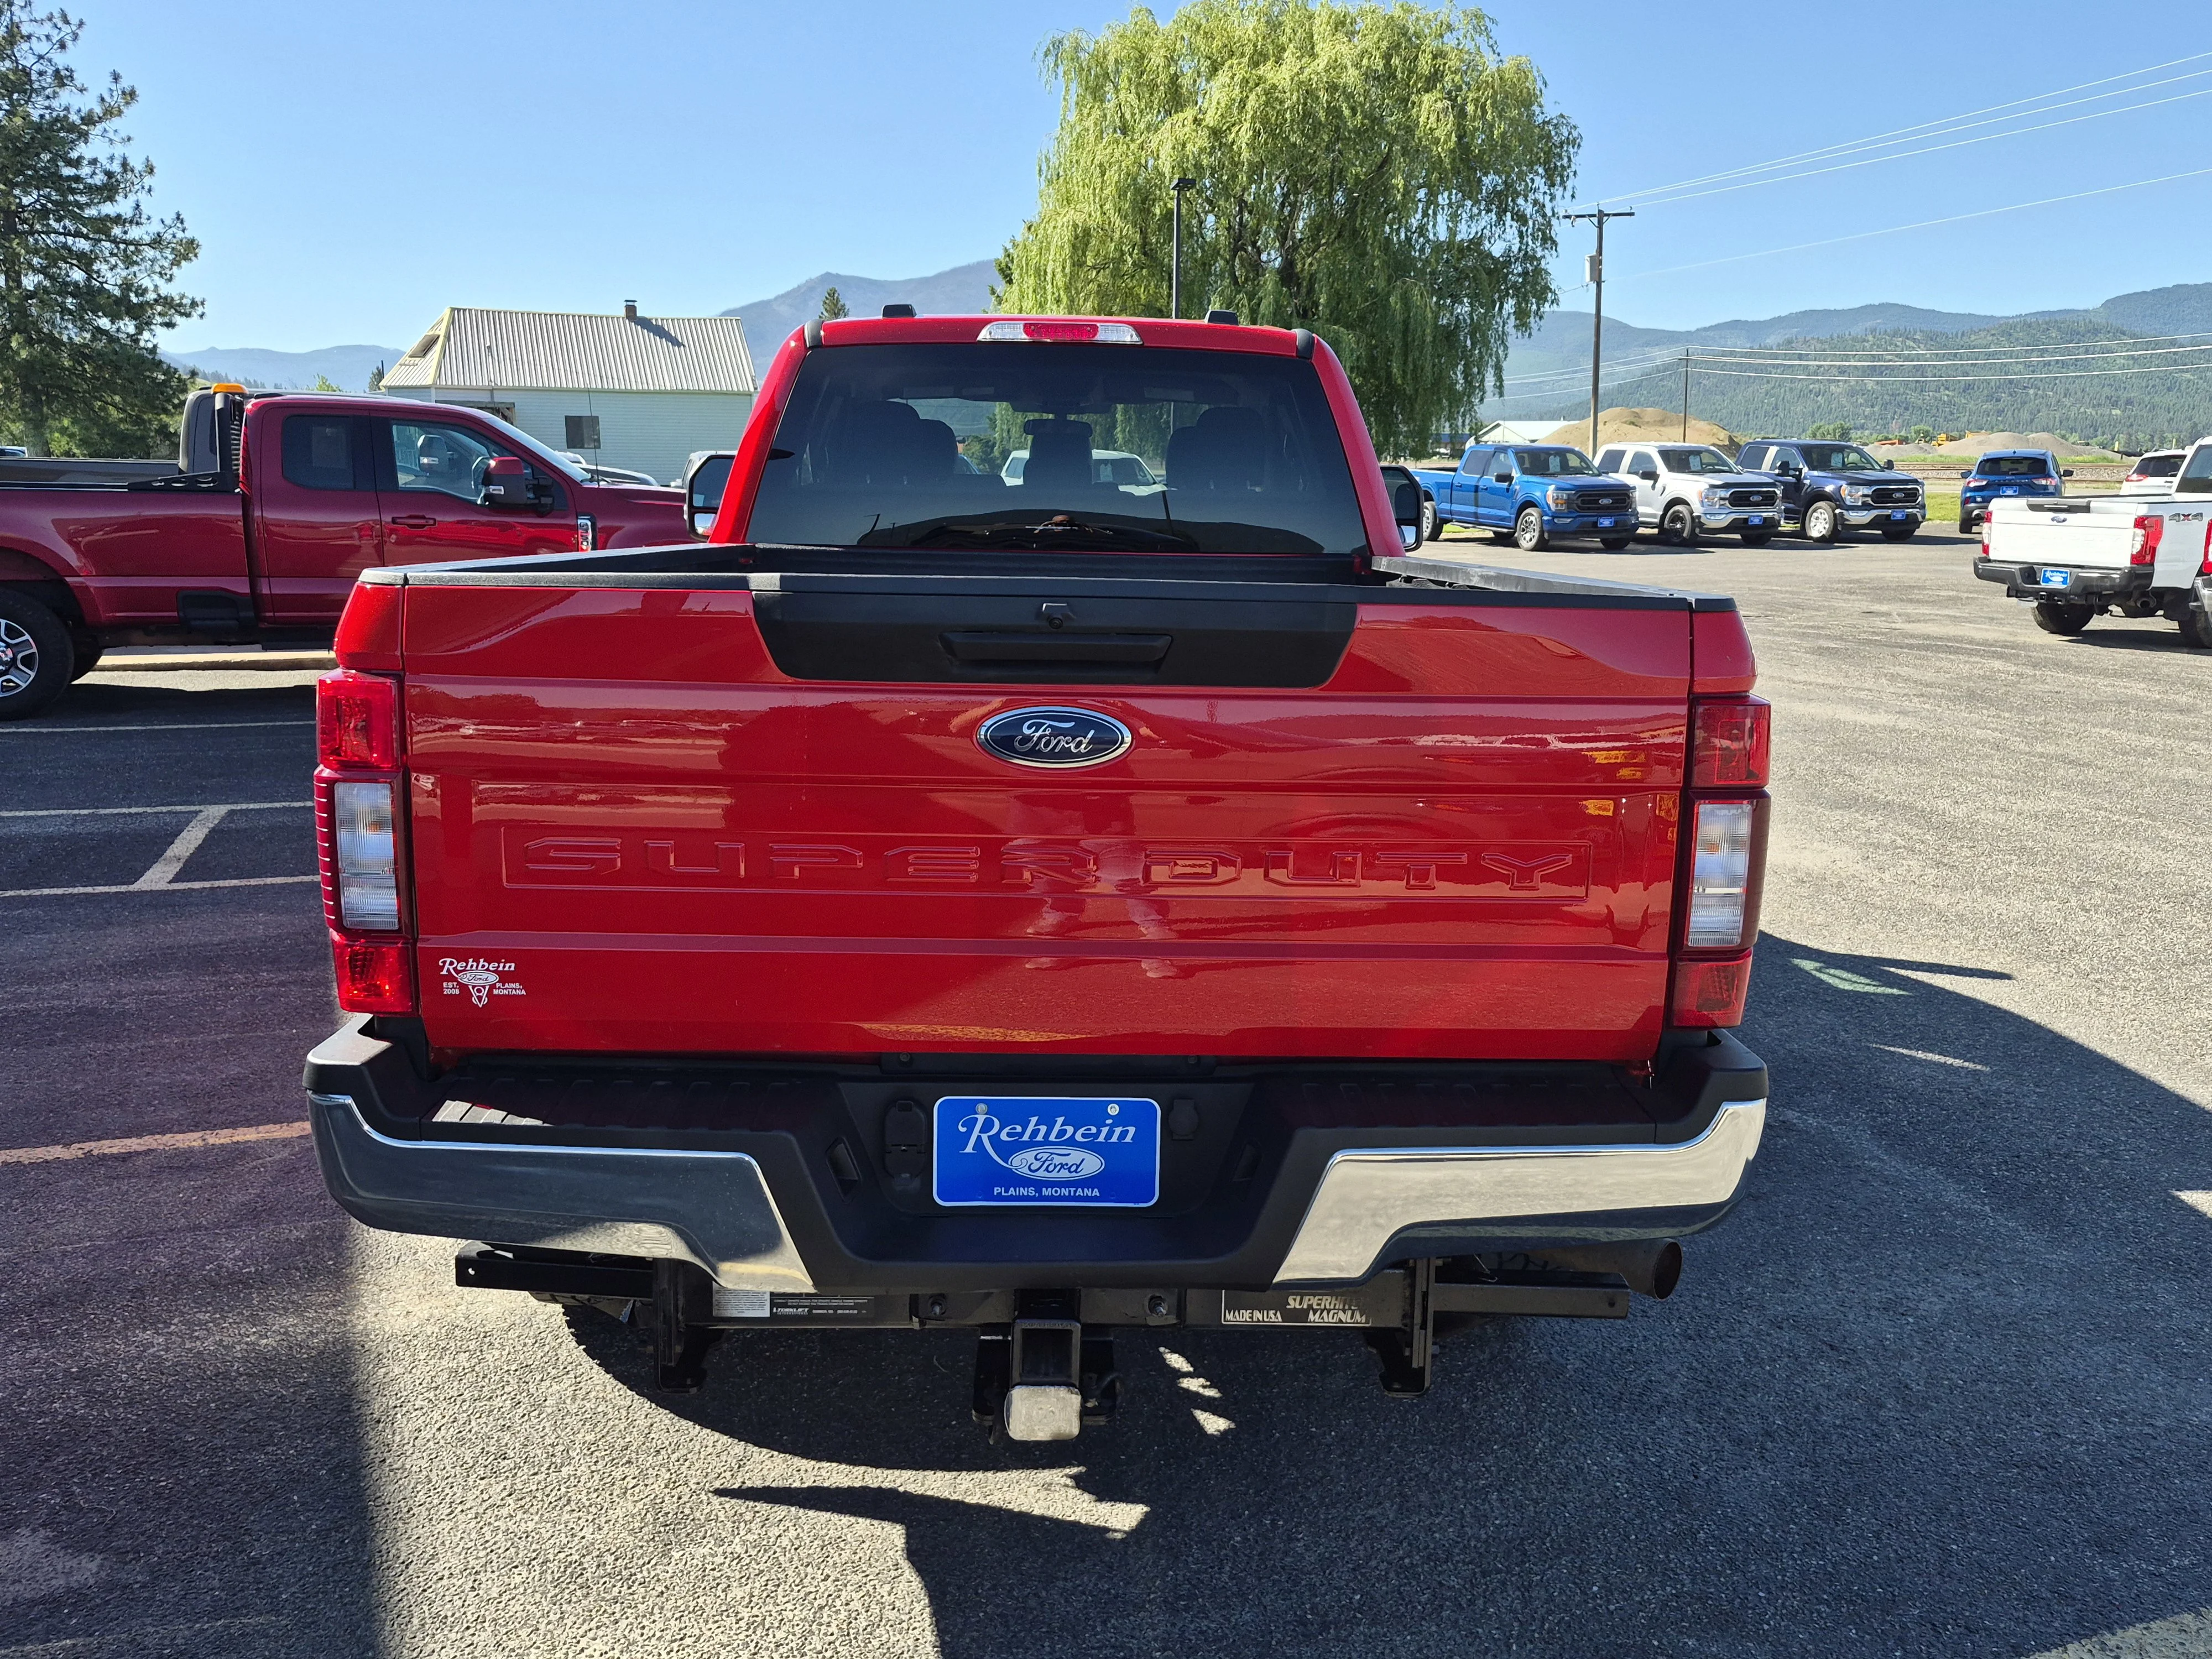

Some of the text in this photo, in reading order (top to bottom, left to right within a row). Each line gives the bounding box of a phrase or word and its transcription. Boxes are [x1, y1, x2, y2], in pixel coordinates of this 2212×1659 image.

[1014, 719, 1095, 753] Ford
[524, 837, 1573, 890] SUPER DUTY
[439, 958, 515, 979] Rehbein
[958, 1114, 1136, 1169] Rehbein
[1028, 1152, 1086, 1174] Ford
[994, 1187, 1100, 1198] PLAINS, MONTANA
[1225, 1310, 1282, 1322] MADE IN USA
[1307, 1310, 1366, 1323] MAGNUM
